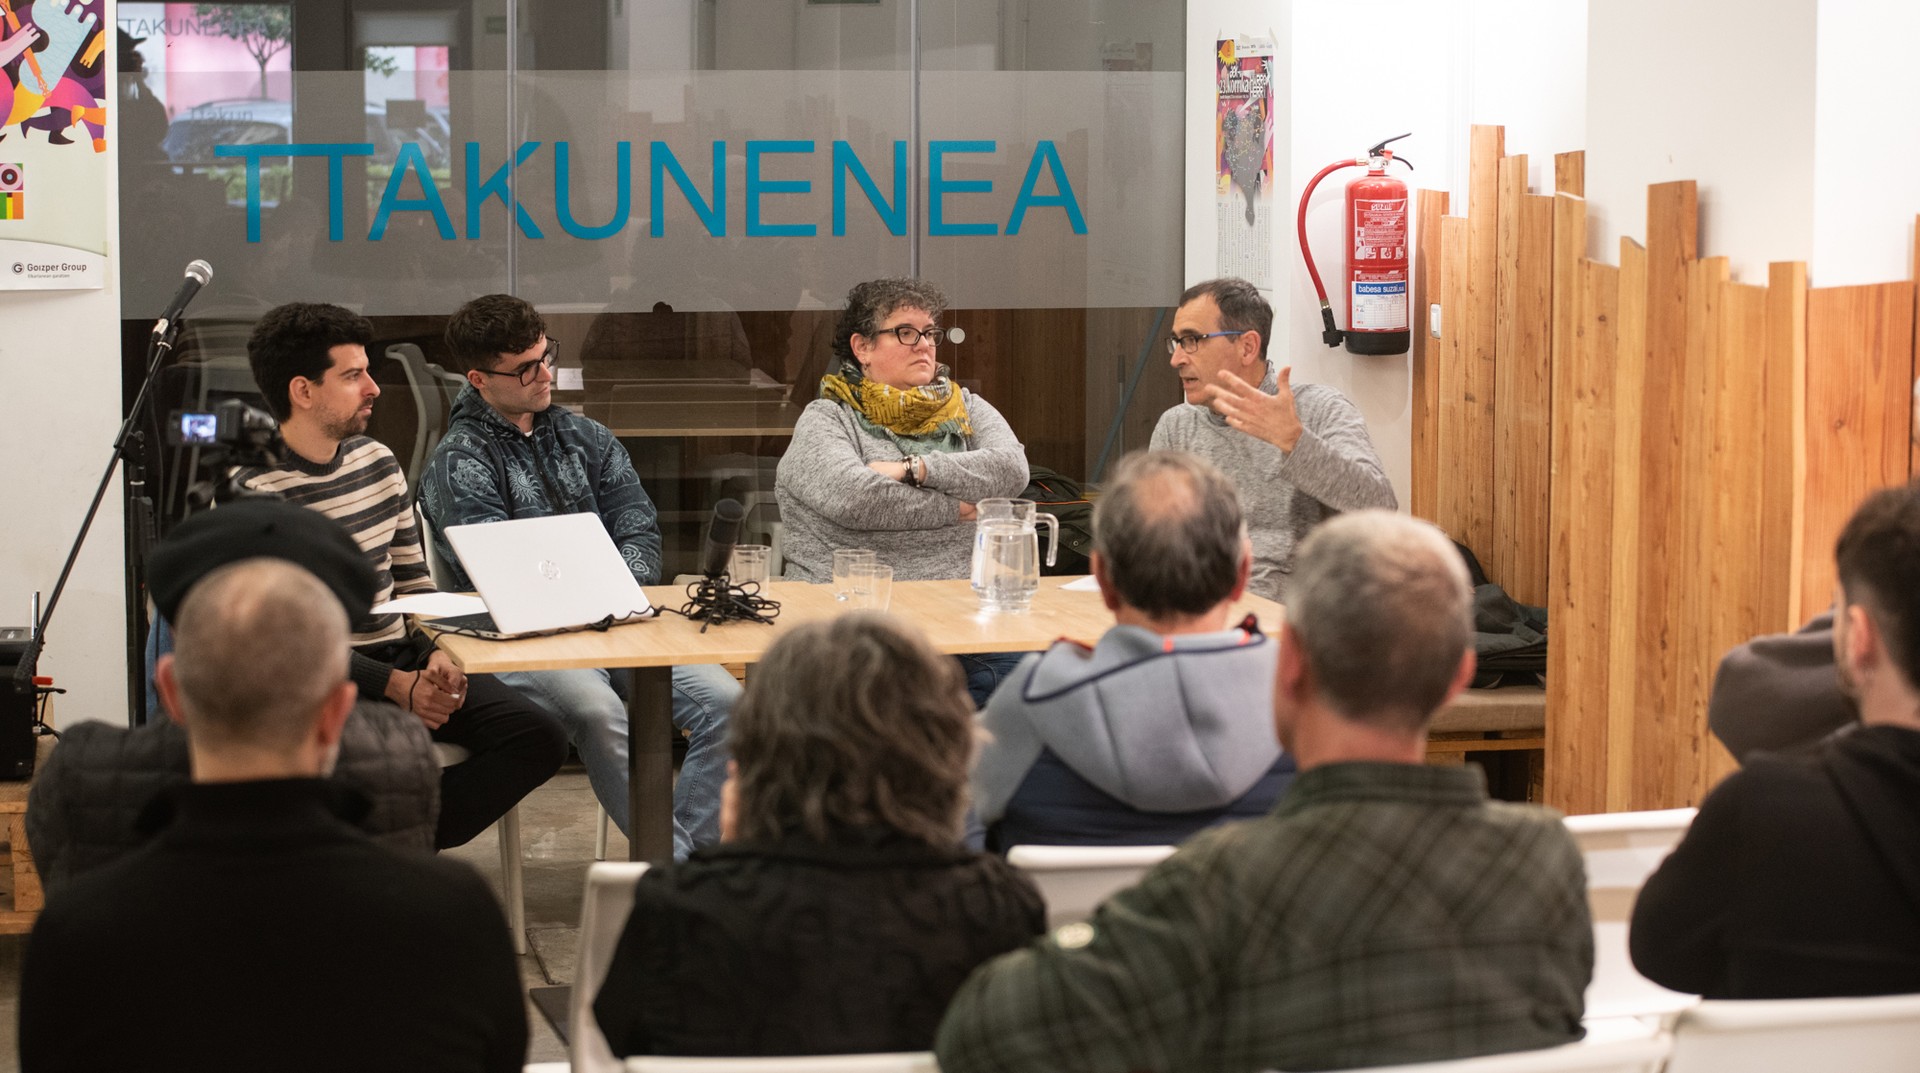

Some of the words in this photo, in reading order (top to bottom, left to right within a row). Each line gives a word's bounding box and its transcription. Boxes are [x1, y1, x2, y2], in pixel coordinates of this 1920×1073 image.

[117, 18, 268, 37] TAKUNENEA
[214, 140, 1088, 243] TTAKUNENEA
[61, 263, 87, 272] Group
[1358, 285, 1381, 293] babesa
